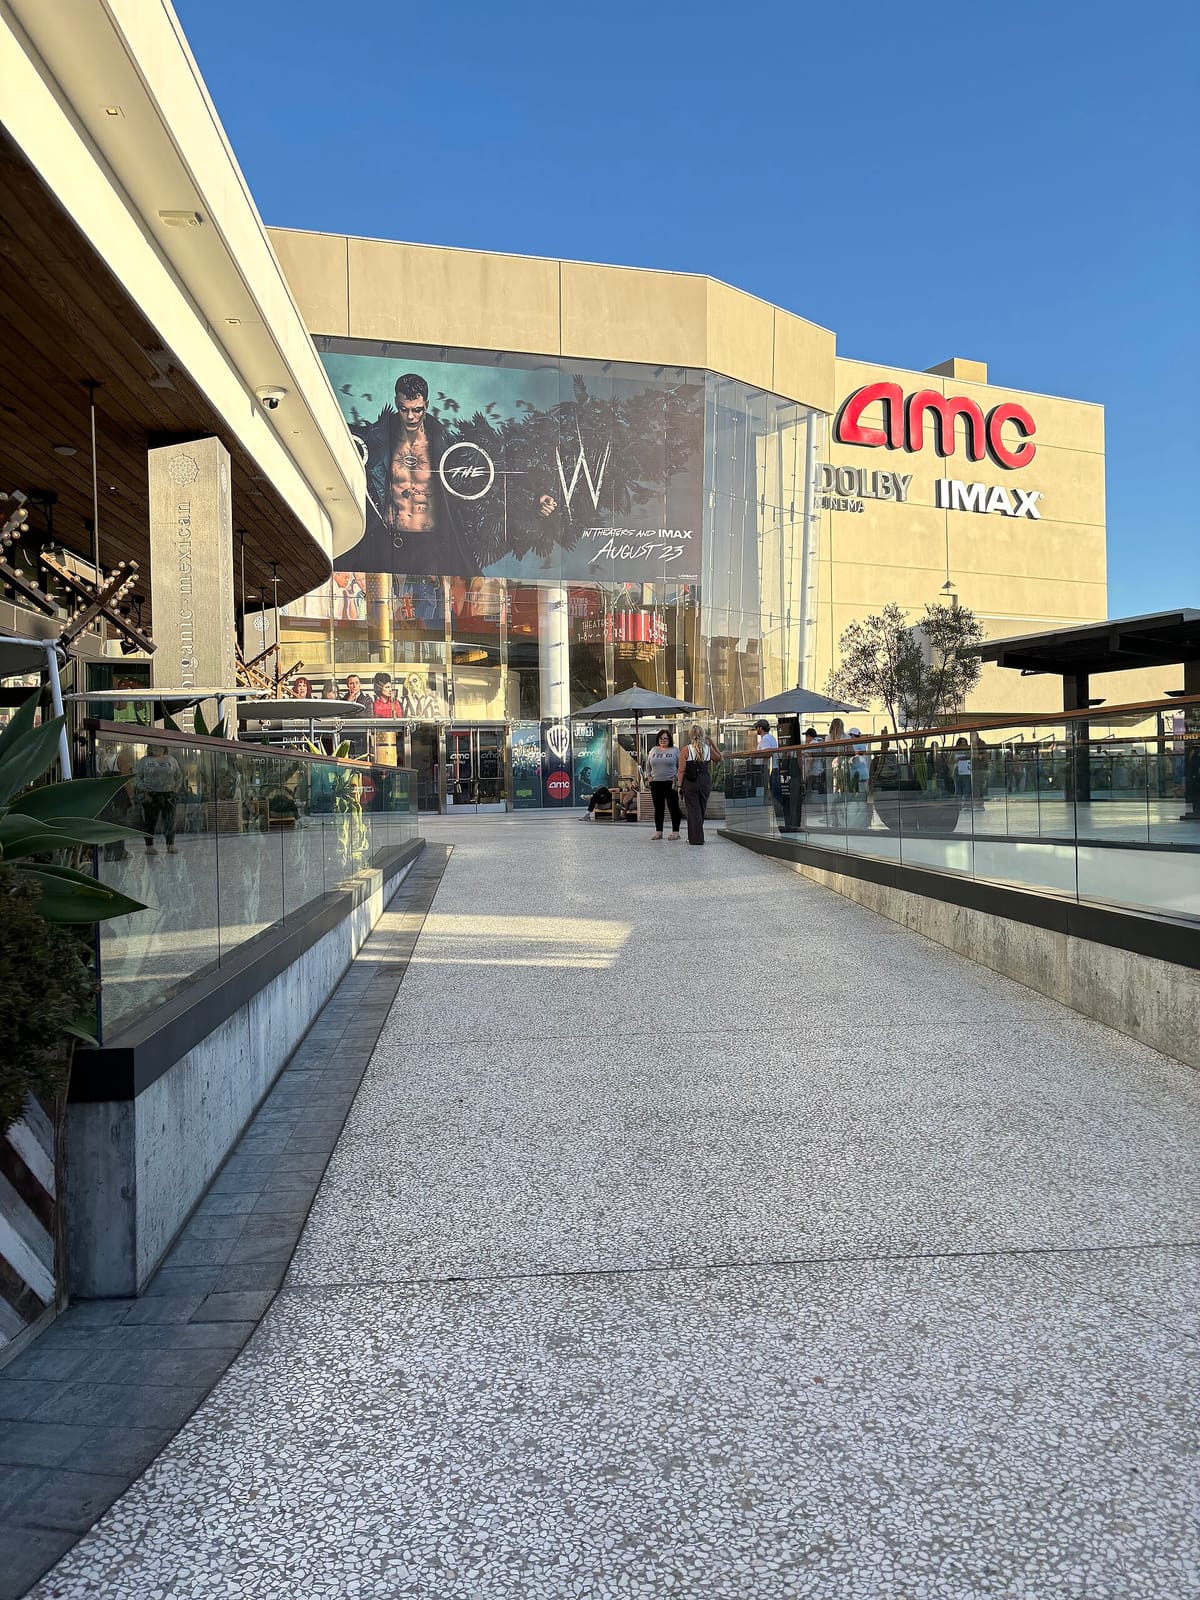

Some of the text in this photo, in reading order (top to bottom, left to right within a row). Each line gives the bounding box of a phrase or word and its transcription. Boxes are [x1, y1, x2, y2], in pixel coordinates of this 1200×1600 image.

[448, 465, 487, 479] THE
[814, 462, 913, 502] DOLBY
[814, 496, 865, 513] CINEMA
[935, 478, 1043, 520] IMAX
[174, 500, 193, 596] mexican
[581, 527, 694, 541] IN THEATERS AND IMAX
[587, 537, 685, 565] AUGUST 23
[175, 608, 200, 688] organic
